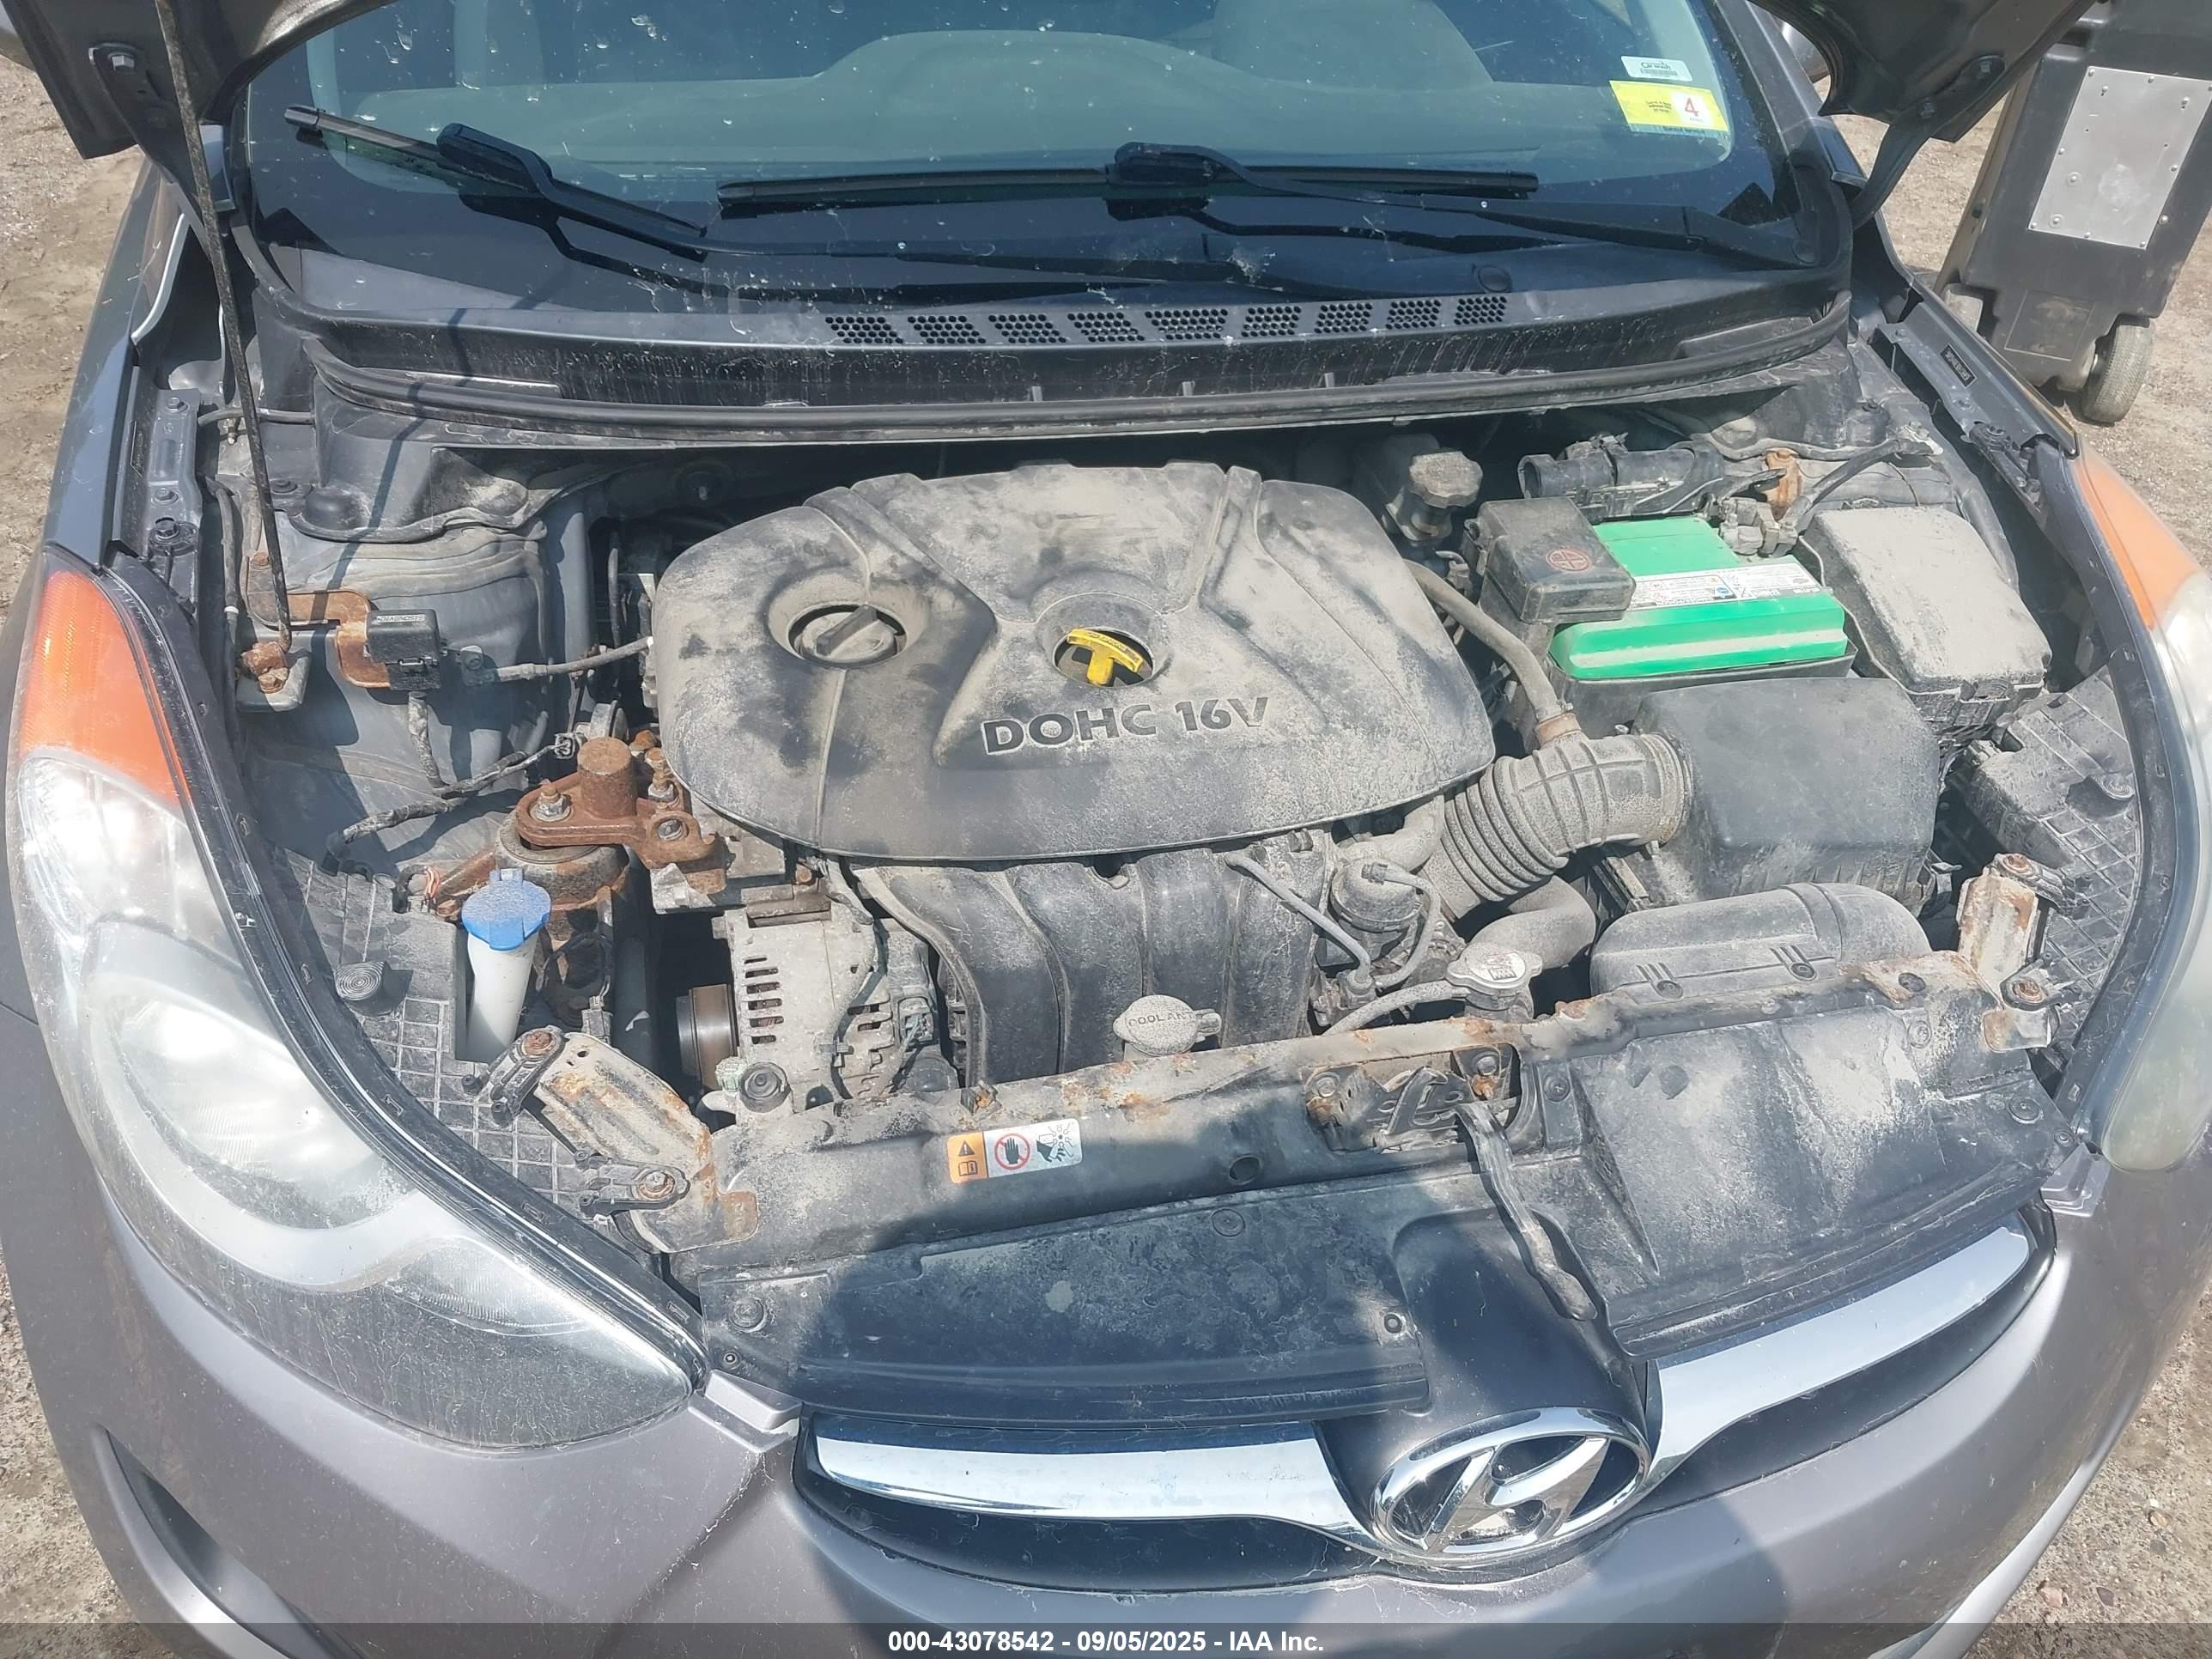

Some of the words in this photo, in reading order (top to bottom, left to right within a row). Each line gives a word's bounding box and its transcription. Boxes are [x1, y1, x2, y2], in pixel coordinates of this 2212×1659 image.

[1685, 97, 1699, 117] 4
[981, 704, 1157, 755] DOHC
[1174, 696, 1268, 732] 16V
